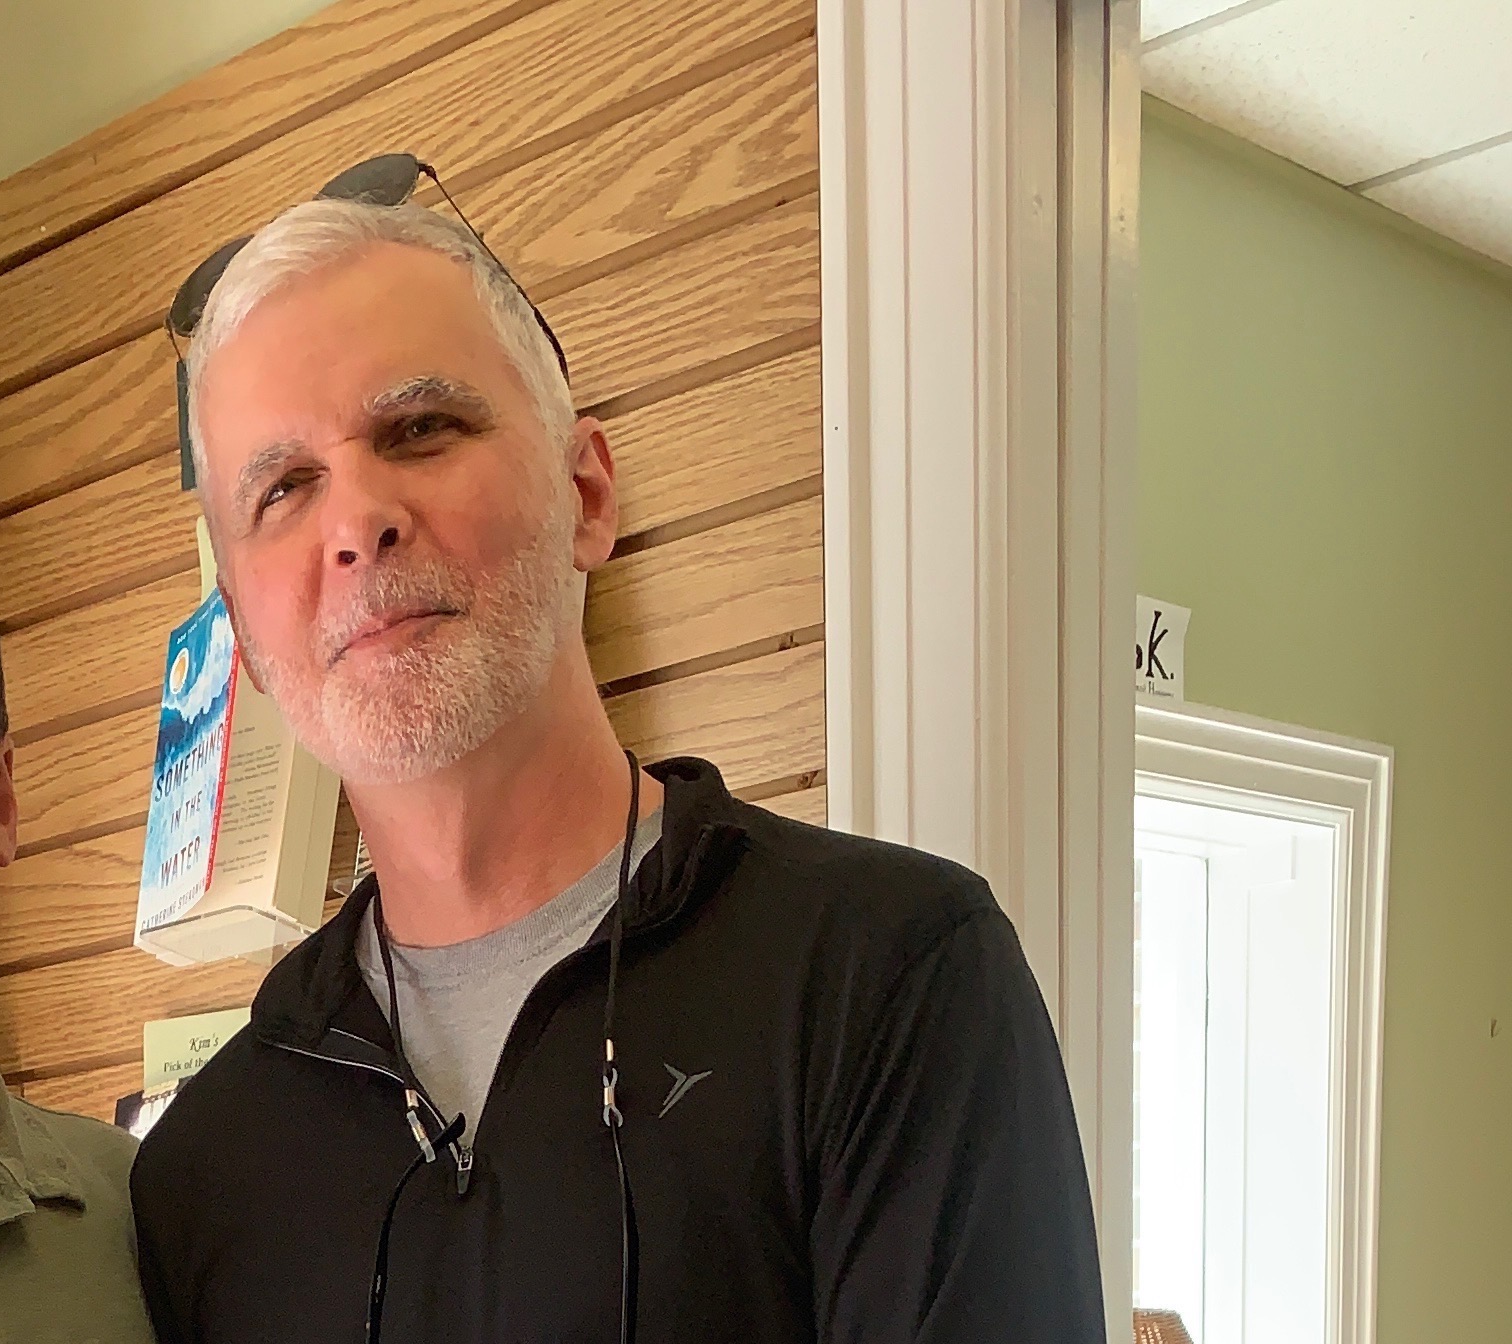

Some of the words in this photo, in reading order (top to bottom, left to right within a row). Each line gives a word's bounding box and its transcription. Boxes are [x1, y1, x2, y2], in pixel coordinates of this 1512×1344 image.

[155, 722, 225, 803] SOMETHING
[170, 804, 183, 834] IN
[185, 790, 204, 823] THE
[160, 836, 202, 890] WATER
[189, 1032, 219, 1053] Kim's
[164, 1059, 182, 1073] Pick
[184, 1058, 194, 1070] of
